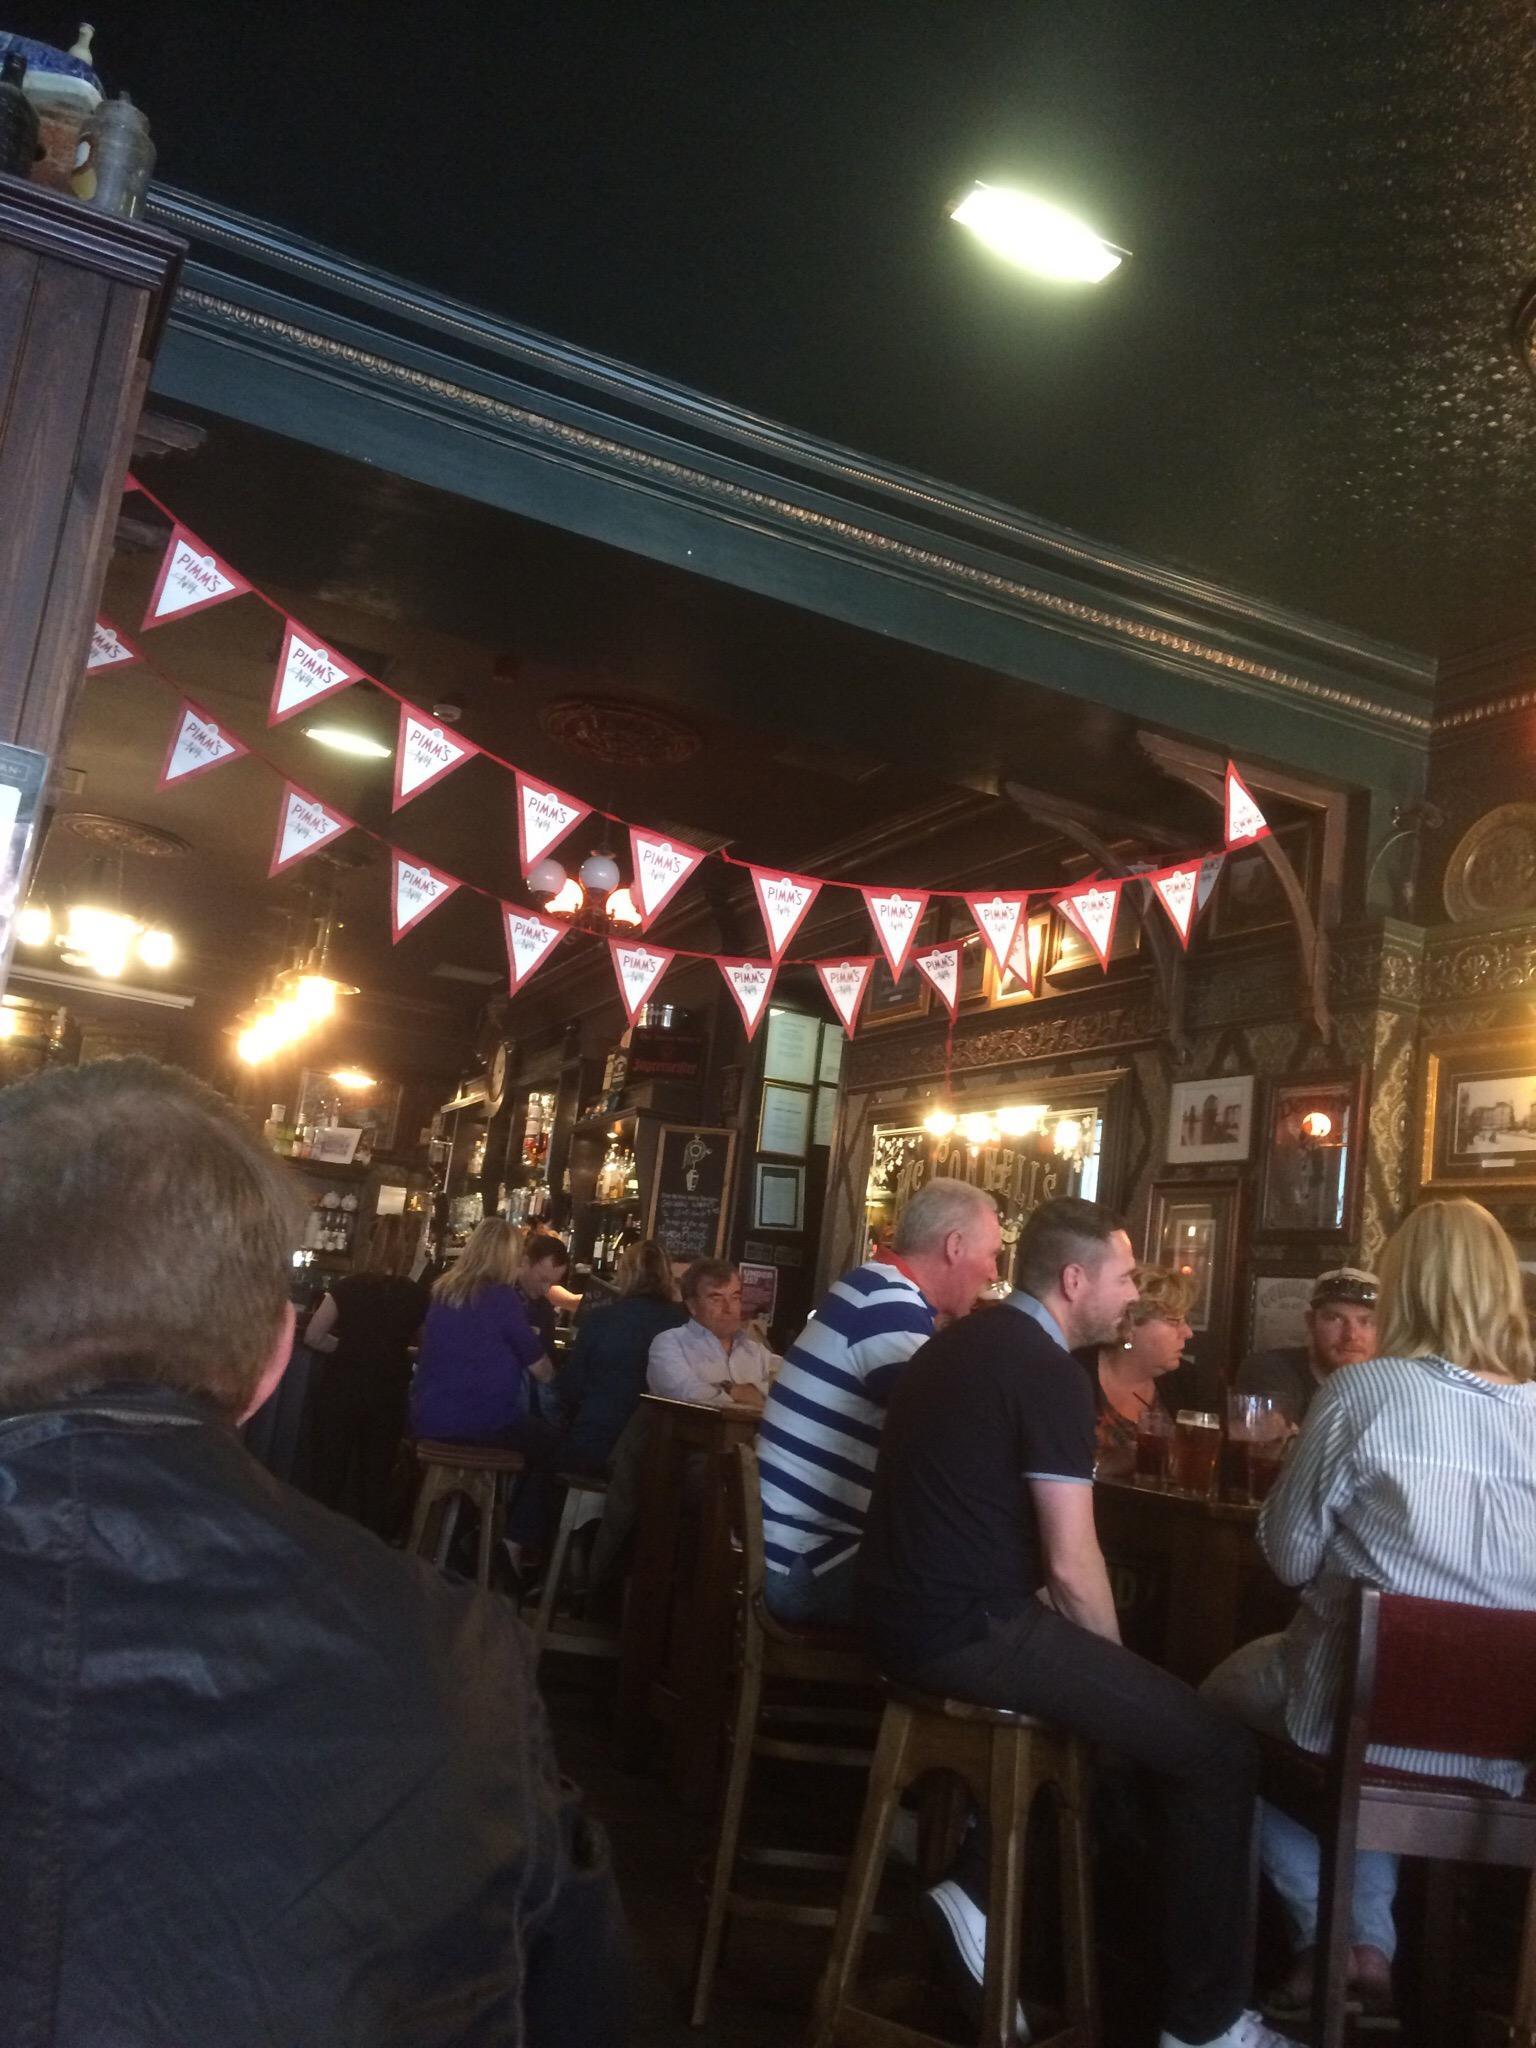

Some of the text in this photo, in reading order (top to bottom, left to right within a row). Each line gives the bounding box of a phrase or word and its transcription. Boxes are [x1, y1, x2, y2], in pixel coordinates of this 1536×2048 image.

[177, 554, 221, 592] PIMM'S
[92, 631, 121, 658] IMM'S
[293, 648, 335, 684] PIMM'S
[185, 722, 223, 756] PIMM'S
[410, 730, 451, 762] PIMM'S
[291, 804, 328, 834] PIMM'S
[528, 797, 567, 824] PIMM'S
[644, 850, 681, 874] PIMM'S
[403, 870, 437, 897] PIMM'S
[768, 887, 802, 906] PIMM'S
[881, 904, 913, 920] PIMM'S
[984, 906, 1015, 921] PIMM'S
[515, 922, 549, 943] PIMM'S
[623, 955, 656, 973] PIMM'S
[830, 969, 860, 983] PIMM'S
[734, 970, 765, 984] PIMM'S
